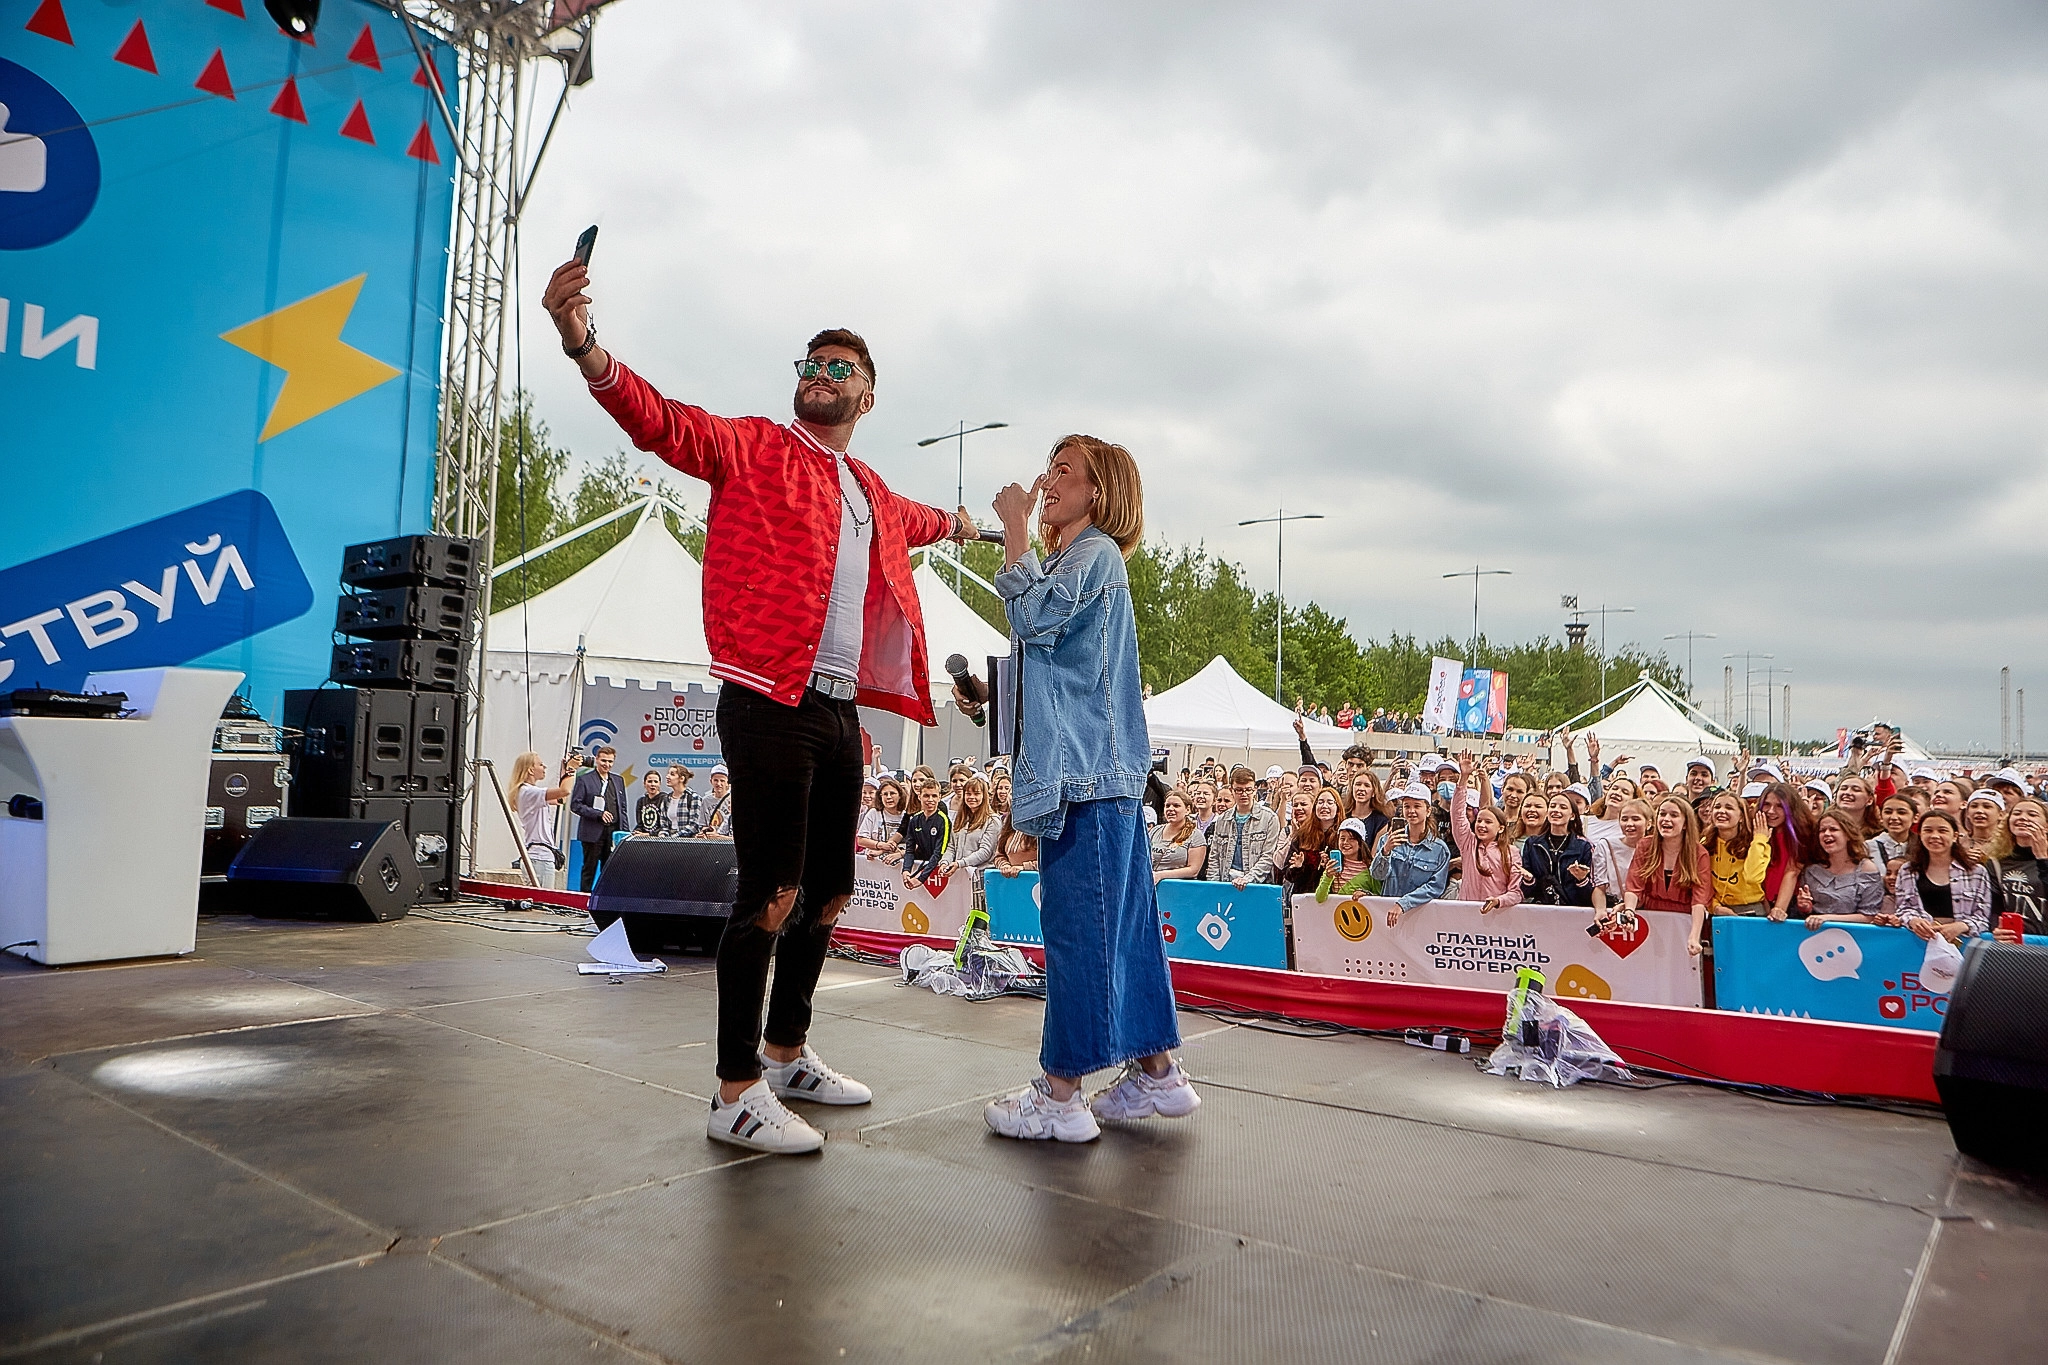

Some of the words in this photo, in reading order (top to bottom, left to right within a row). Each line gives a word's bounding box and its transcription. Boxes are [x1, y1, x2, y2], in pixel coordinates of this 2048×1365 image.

[0, 296, 99, 370] И
[1436, 932, 1536, 949] ГЛАВНЫЙ
[1425, 944, 1551, 963] ФЕСТИВАЛЬ
